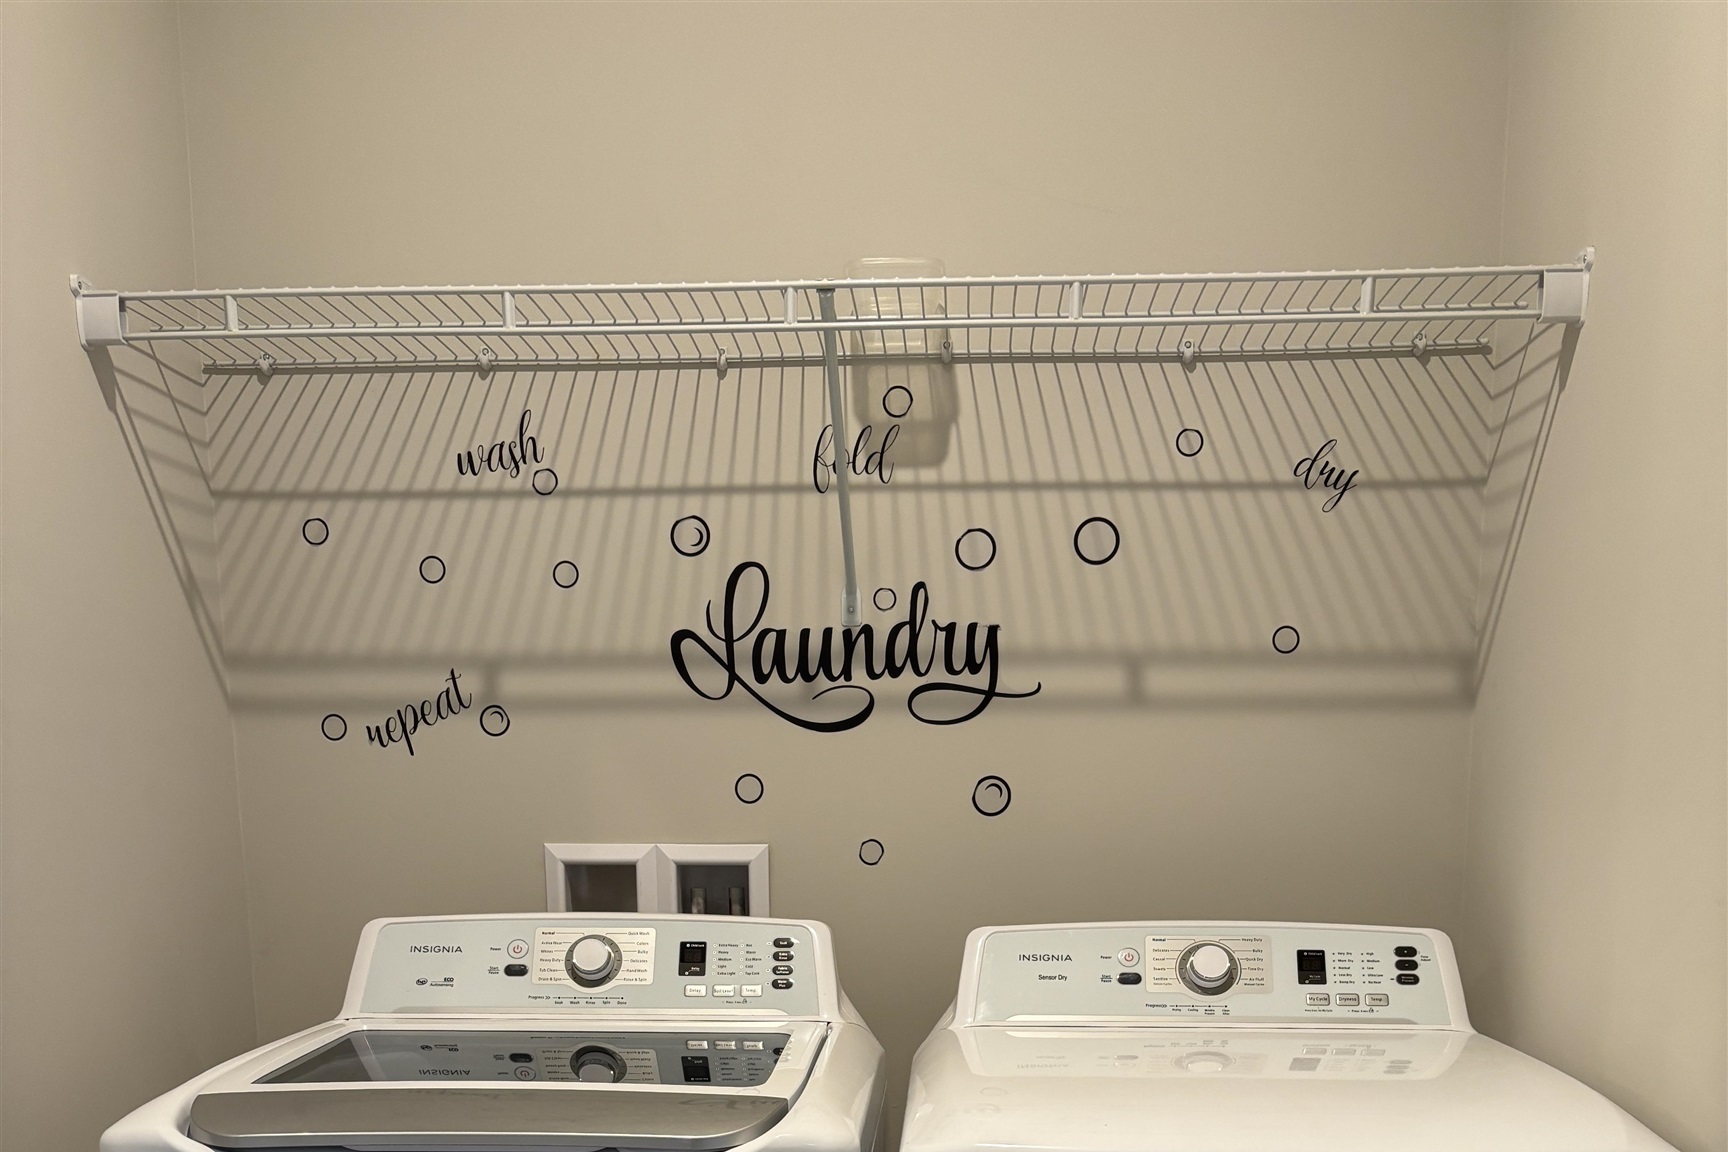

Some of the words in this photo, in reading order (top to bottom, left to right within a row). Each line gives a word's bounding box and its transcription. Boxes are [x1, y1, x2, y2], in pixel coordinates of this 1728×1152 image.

[457, 409, 544, 478] wash
[1293, 438, 1359, 513] dry
[670, 561, 1041, 733] Laundry
[366, 667, 472, 756] repeat
[410, 945, 463, 953] INSIGNIA
